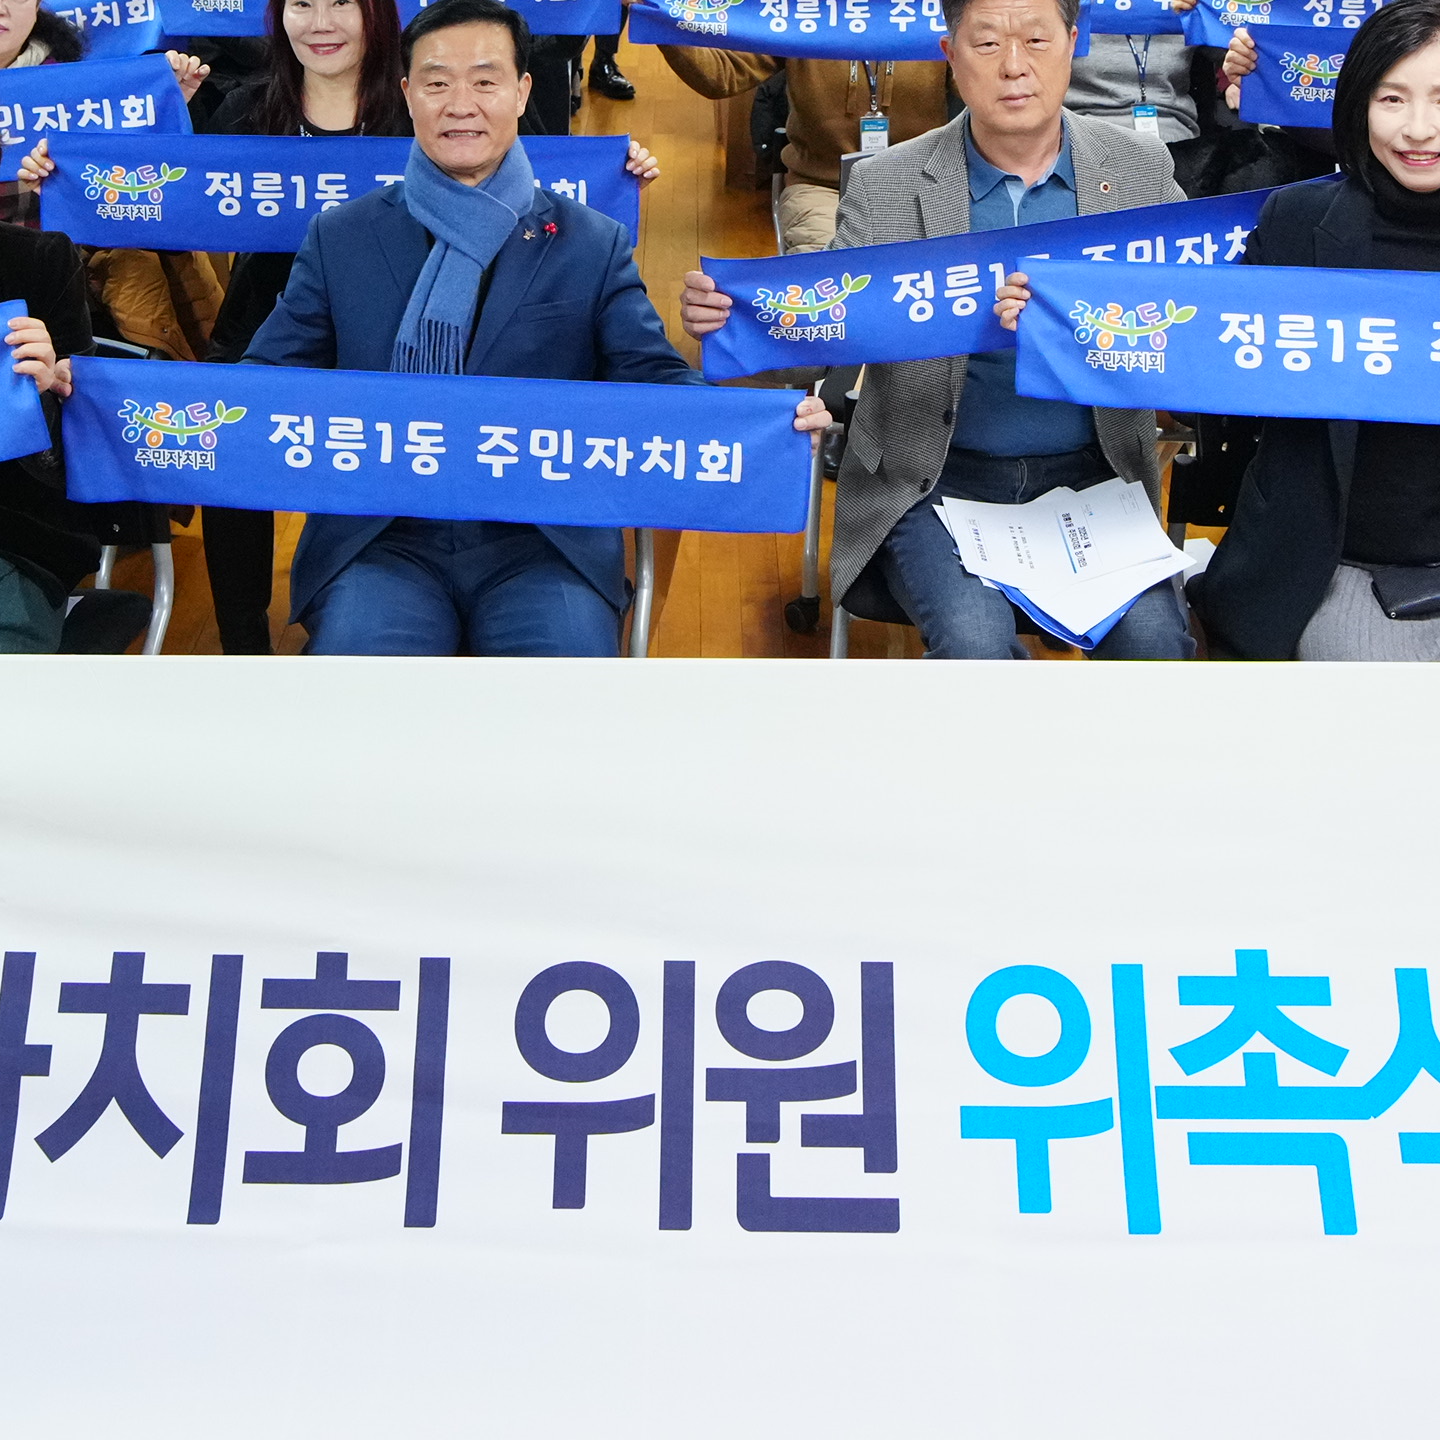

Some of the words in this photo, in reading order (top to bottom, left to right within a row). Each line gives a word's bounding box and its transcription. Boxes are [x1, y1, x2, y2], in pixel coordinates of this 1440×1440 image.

[81, 163, 164, 205] 정릉1동
[205, 171, 350, 216] 정릉1동
[95, 201, 162, 221] 주민자치회
[752, 279, 847, 328] 정릉1동
[893, 254, 1050, 323] 정릉1
[767, 321, 846, 342] 주민자치회
[1070, 298, 1169, 351] 정릉1동
[1219, 313, 1399, 375] 정릉1동
[1084, 345, 1166, 374] 주민자치회
[117, 398, 220, 450] 정릉1동
[269, 415, 446, 475] 정릉1동
[477, 426, 742, 483] 주민자치회
[134, 447, 216, 471] 주민자치회
[500, 957, 902, 1235] 위원
